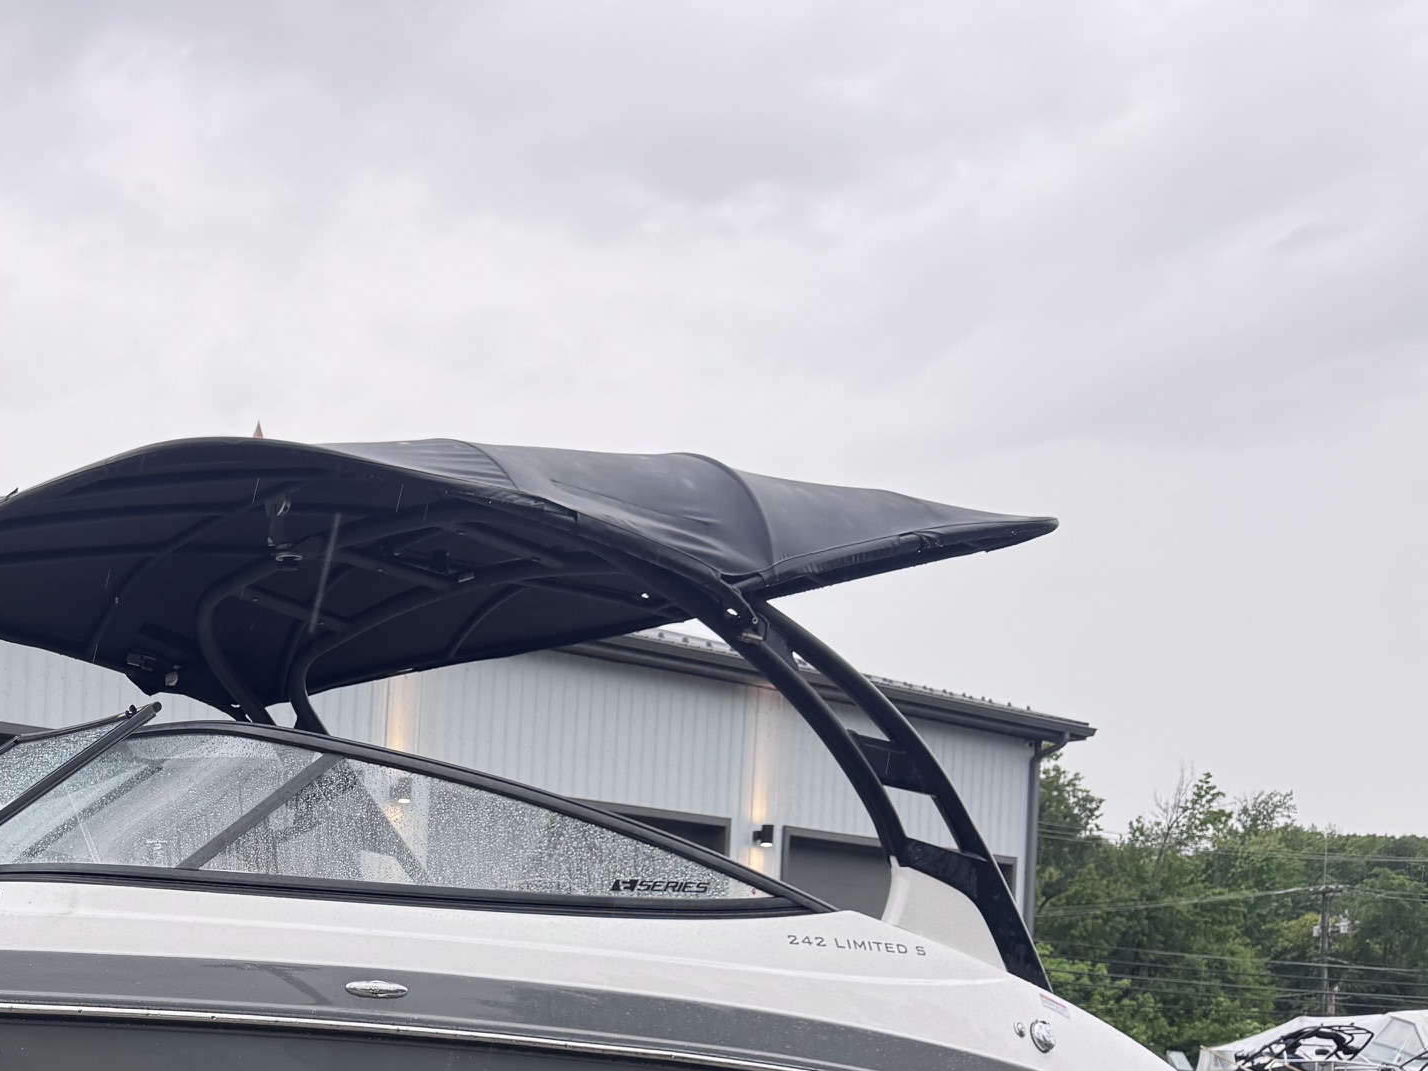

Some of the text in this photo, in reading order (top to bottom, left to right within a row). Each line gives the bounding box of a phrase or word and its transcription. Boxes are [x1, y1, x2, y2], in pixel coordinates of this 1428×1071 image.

[637, 880, 710, 893] SERIES
[787, 934, 927, 956] 242 LIMITED S
